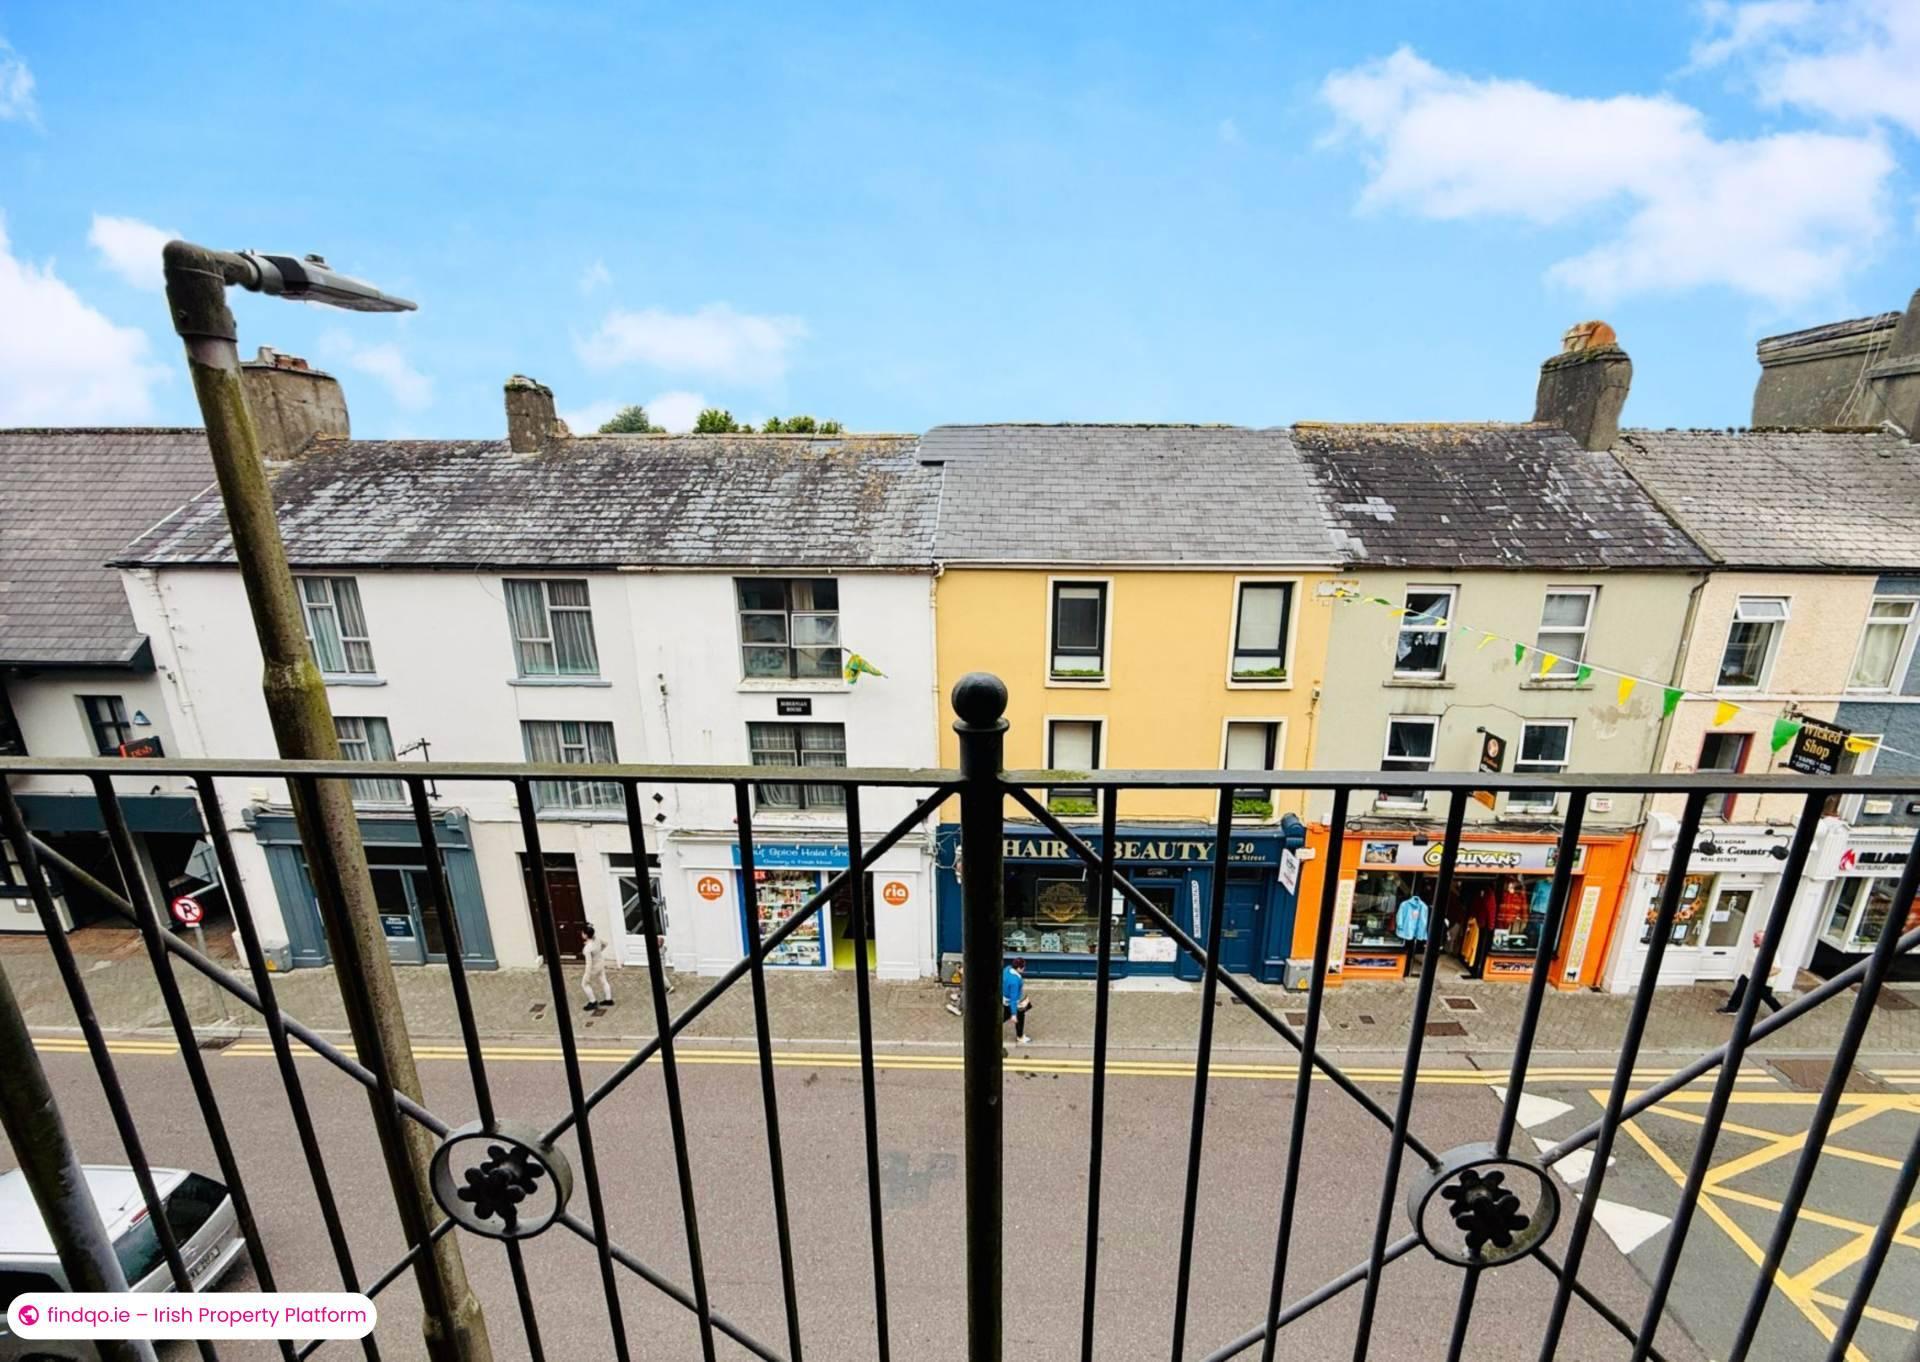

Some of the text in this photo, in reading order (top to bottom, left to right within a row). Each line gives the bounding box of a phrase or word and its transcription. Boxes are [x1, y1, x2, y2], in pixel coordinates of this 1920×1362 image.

[1802, 738, 1830, 760] Shop
[801, 848, 828, 857] Halal
[829, 848, 850, 857] Sho
[1003, 839, 1070, 859] HAIR
[1112, 841, 1215, 861] BEAUTY
[1236, 842, 1255, 854] 20
[700, 878, 721, 893] ria
[885, 884, 906, 897] ria
